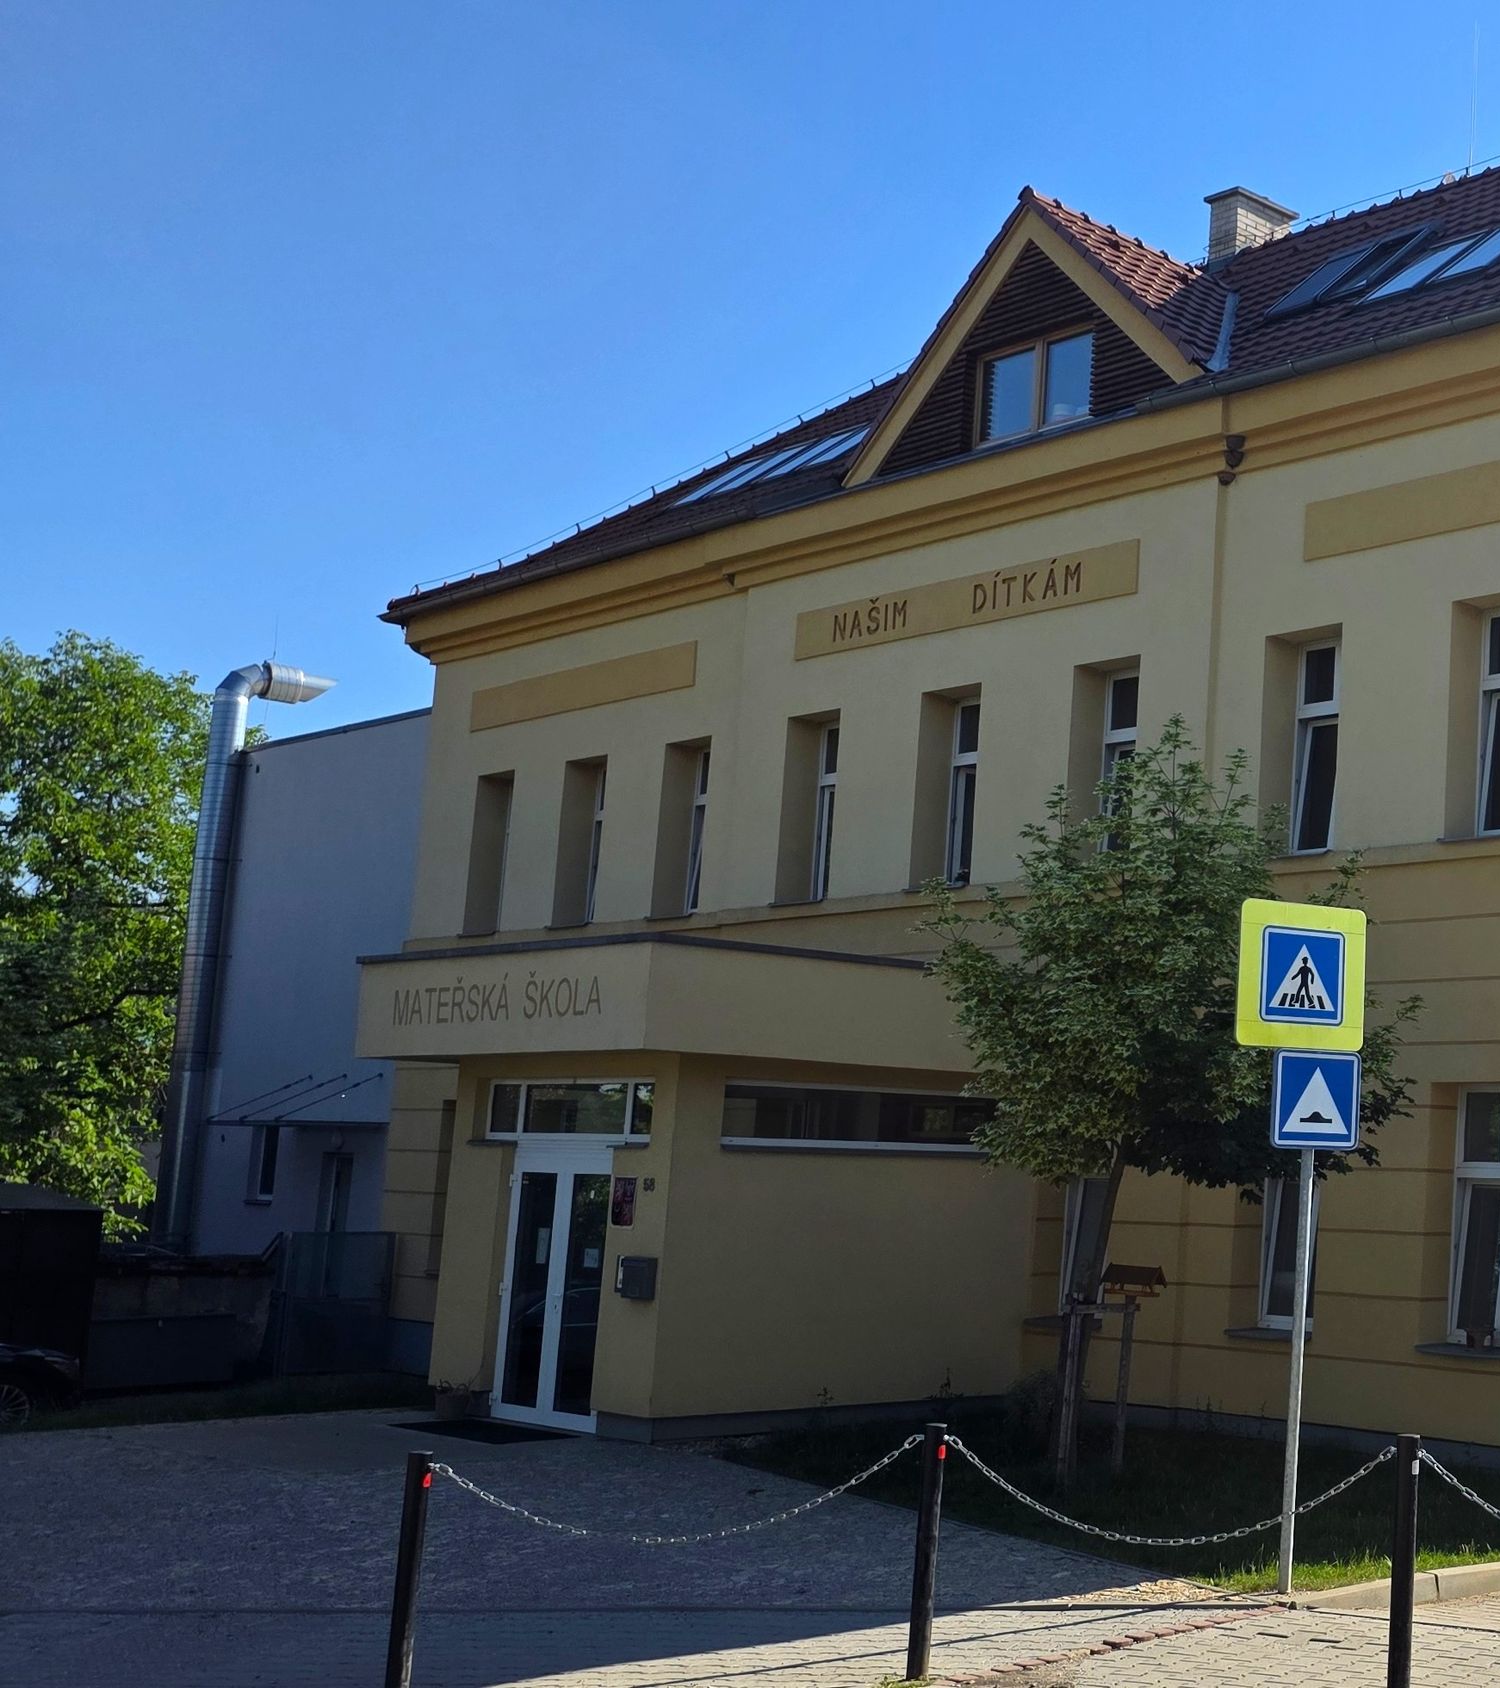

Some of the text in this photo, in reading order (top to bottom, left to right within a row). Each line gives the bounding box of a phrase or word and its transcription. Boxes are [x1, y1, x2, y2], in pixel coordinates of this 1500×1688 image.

[832, 558, 1082, 643] NAŠIM DÍTKÁM
[392, 970, 602, 1026] MATEŘSKÁ ŠKOLA
[643, 1177, 656, 1192] 58
